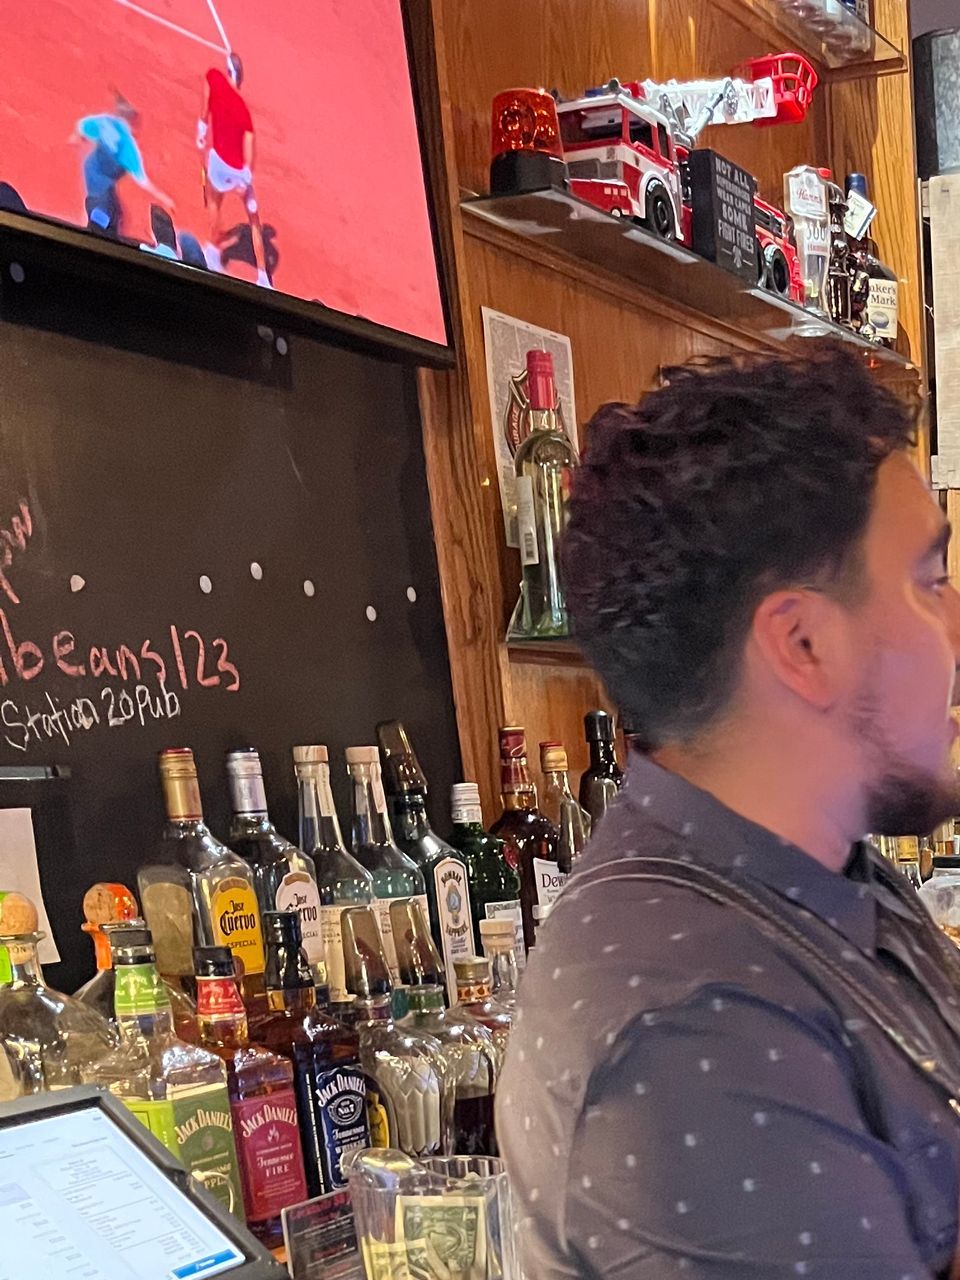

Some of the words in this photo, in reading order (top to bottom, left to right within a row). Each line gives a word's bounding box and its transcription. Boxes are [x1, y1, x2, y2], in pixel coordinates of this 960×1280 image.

[715, 157, 731, 178] NOT
[734, 169, 750, 191] ALL
[722, 203, 748, 233] SOME
[869, 283, 897, 295] aker's
[870, 294, 897, 306] Mark
[541, 872, 565, 888] Dew
[219, 910, 256, 937] Cuervo
[314, 1080, 339, 1107] JACK
[336, 1073, 367, 1097] DANIEL'S
[174, 1115, 199, 1145] JACK
[196, 1108, 233, 1133] DANIEL'S
[240, 1112, 265, 1138] JACK
[263, 1104, 298, 1127] DANIEL'S
[264, 1163, 290, 1178] FIRE
